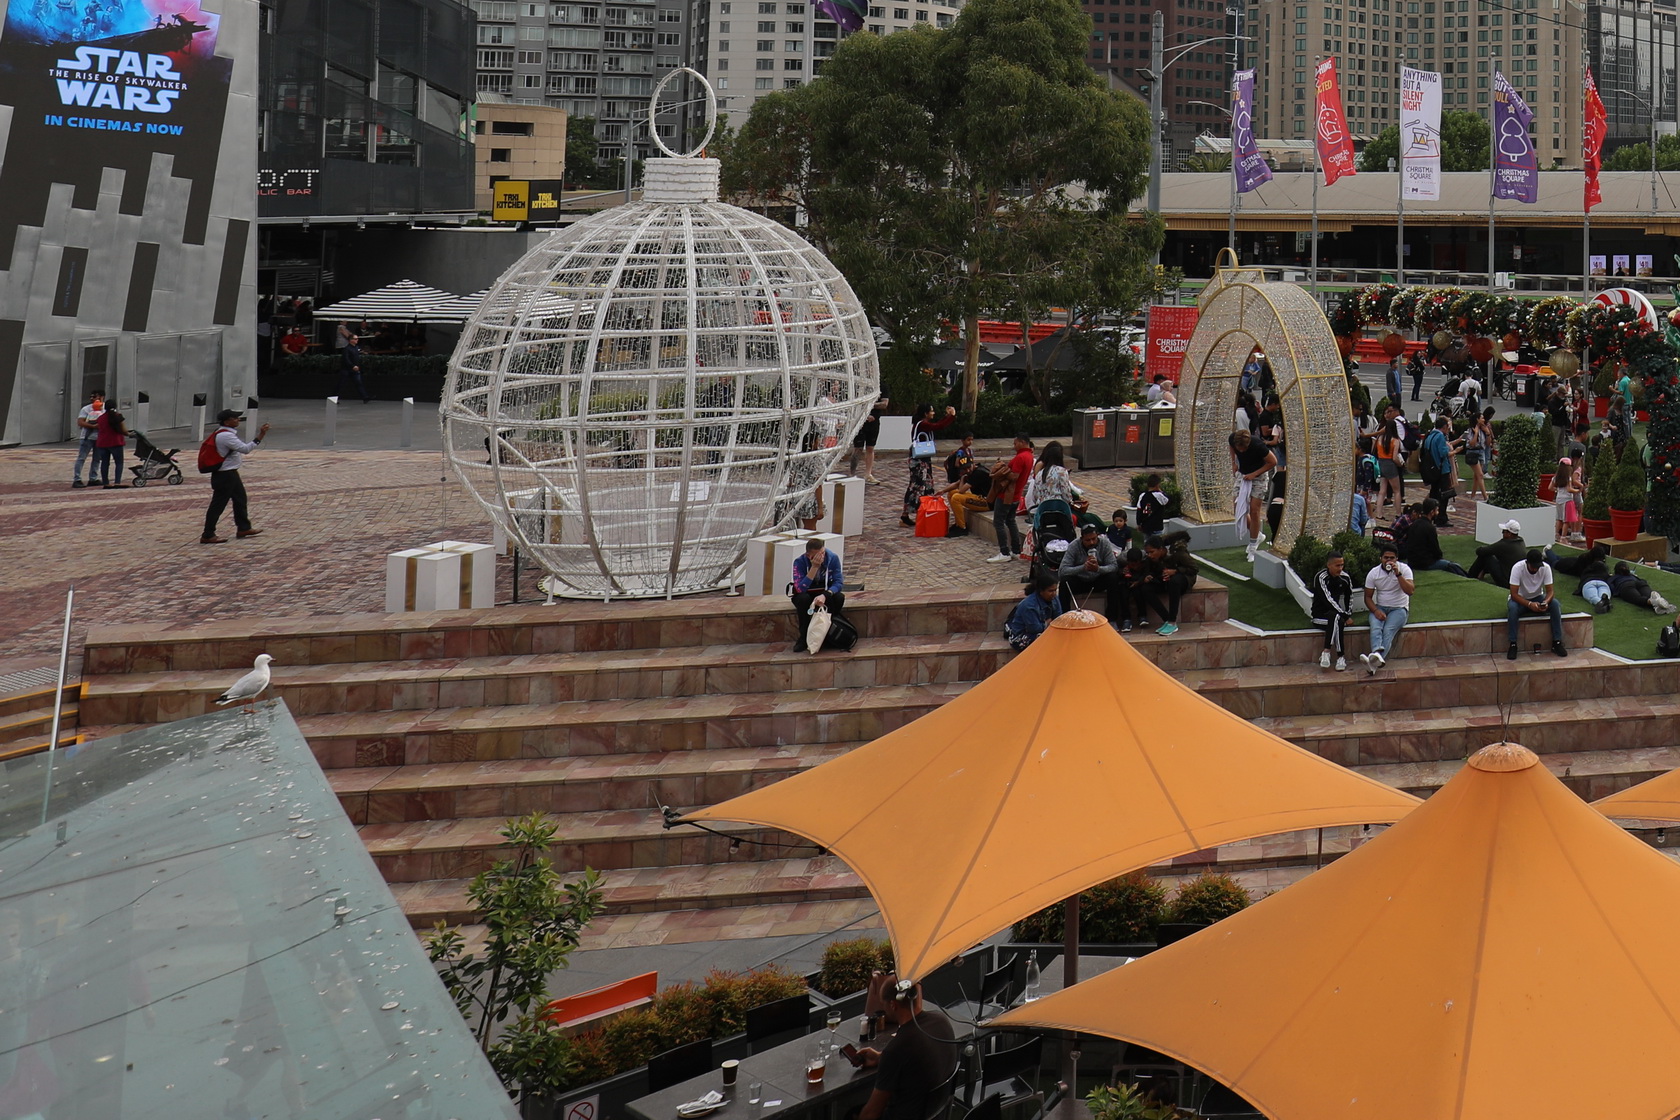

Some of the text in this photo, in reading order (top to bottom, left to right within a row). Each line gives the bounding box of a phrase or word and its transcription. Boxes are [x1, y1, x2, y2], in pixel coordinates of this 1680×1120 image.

[57, 46, 181, 80] STAR
[49, 69, 188, 90] THE RISE OF SKYWALKER
[1403, 69, 1437, 83] ANYTHING
[1403, 80, 1421, 91] BUT A
[56, 78, 179, 114] WARS
[1402, 90, 1424, 101] SILENT
[1402, 101, 1421, 111] NIGHT
[45, 115, 183, 135] IN CINEMAS NOW
[1502, 175, 1525, 183] SQUARE
[532, 200, 557, 208] KITCHEN
